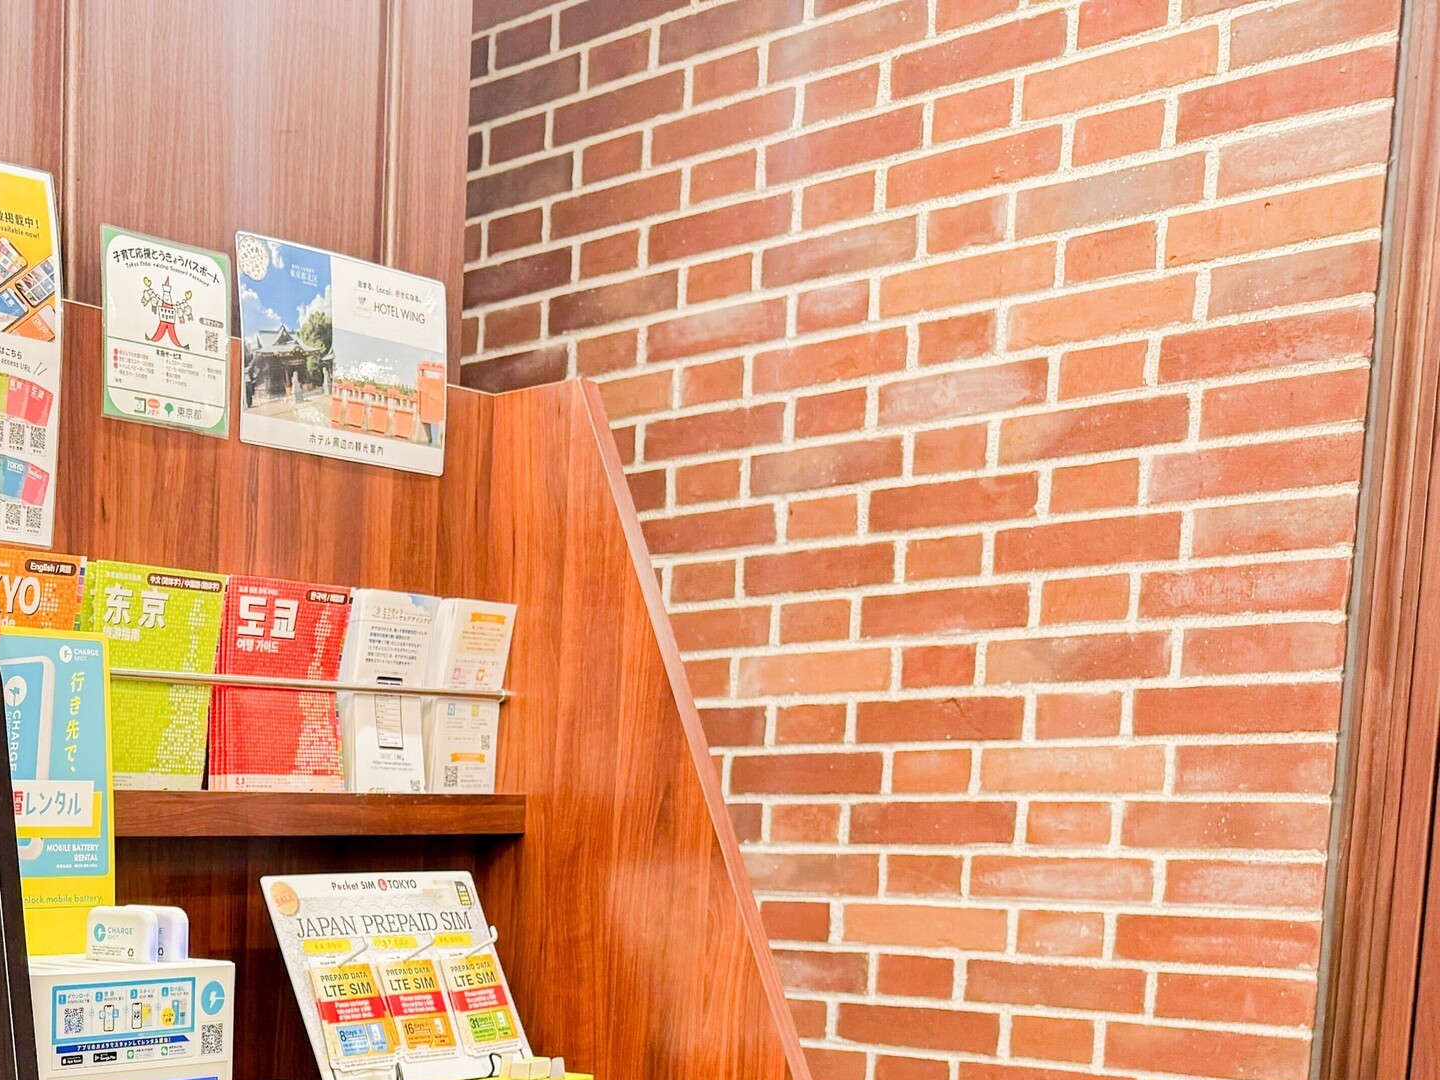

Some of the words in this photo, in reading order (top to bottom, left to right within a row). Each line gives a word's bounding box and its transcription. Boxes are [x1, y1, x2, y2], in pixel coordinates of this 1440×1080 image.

[25, 230, 39, 239] now!
[373, 301, 398, 318] HOTEL
[402, 308, 425, 324] WING
[0, 358, 19, 368] access
[20, 363, 30, 372] URL
[30, 562, 55, 573] English
[104, 582, 170, 629] 东京
[237, 595, 299, 640] 도쿄
[237, 638, 254, 652] 여행
[256, 639, 279, 653] 가이드
[74, 648, 99, 656] CHARGE
[64, 671, 85, 773] 行き先で、
[47, 844, 71, 852] MOBILE
[72, 844, 99, 852] BATTERY
[74, 853, 98, 862] RENTAL
[331, 881, 359, 891] Pocket
[361, 881, 376, 890] SIM
[389, 879, 417, 889] TOKYO
[24, 894, 44, 904] nlock
[46, 893, 72, 903] mobile
[74, 892, 104, 904] battery.
[297, 915, 357, 938] JAPAN
[360, 912, 438, 933] PREPAID
[440, 911, 472, 931] SIM
[108, 927, 133, 936] CHARGE
[386, 968, 413, 976] PREPAID
[450, 964, 476, 973] PREPAID
[476, 961, 492, 970] DATA
[320, 973, 349, 982] PREPAID
[351, 971, 368, 979] DATA
[454, 975, 475, 988] LTE
[477, 972, 496, 984] SIM
[323, 985, 347, 998] LTE
[350, 982, 373, 995] SIM
[389, 979, 411, 991] LTE
[415, 977, 435, 990] SIM
[403, 1023, 414, 1035] 16
[469, 1017, 480, 1029] 31
[341, 1030, 347, 1042] 8
